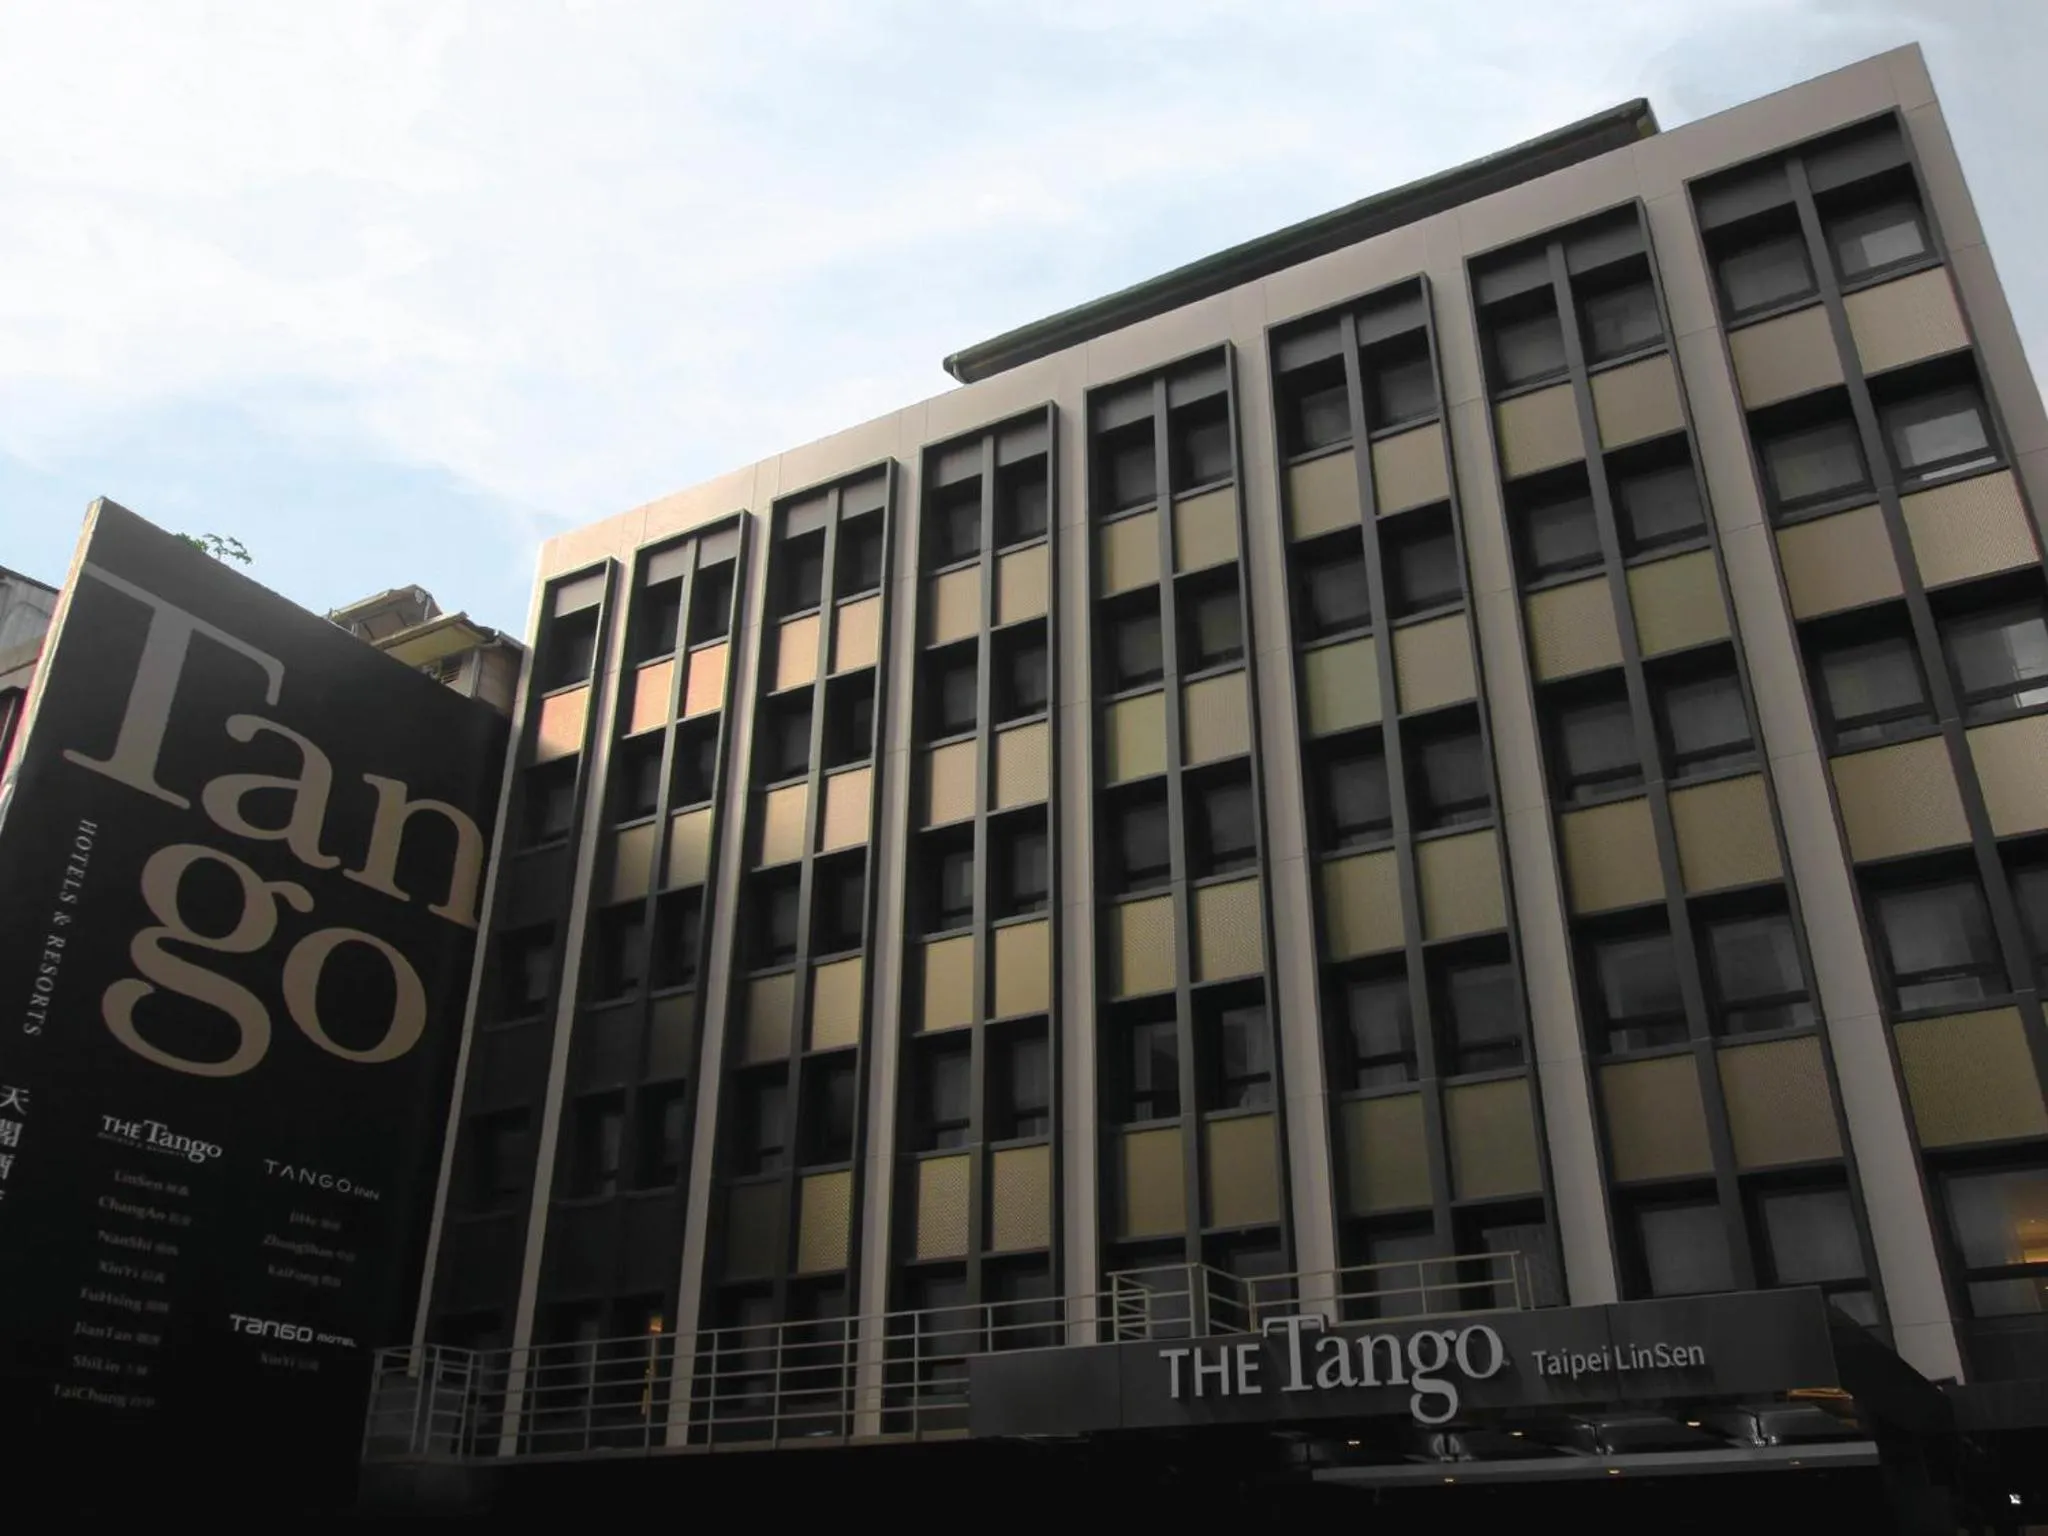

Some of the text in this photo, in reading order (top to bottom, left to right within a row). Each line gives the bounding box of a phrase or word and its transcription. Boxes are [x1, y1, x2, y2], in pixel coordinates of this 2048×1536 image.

[22, 818, 99, 1036] HOTELS & RESORTS
[102, 1113, 142, 1140] THE
[143, 1119, 223, 1163] Tango
[263, 1158, 351, 1193] TANGO
[1158, 1312, 1505, 1425] THE Tango
[1531, 1341, 1706, 1381] Taipei LinSen
